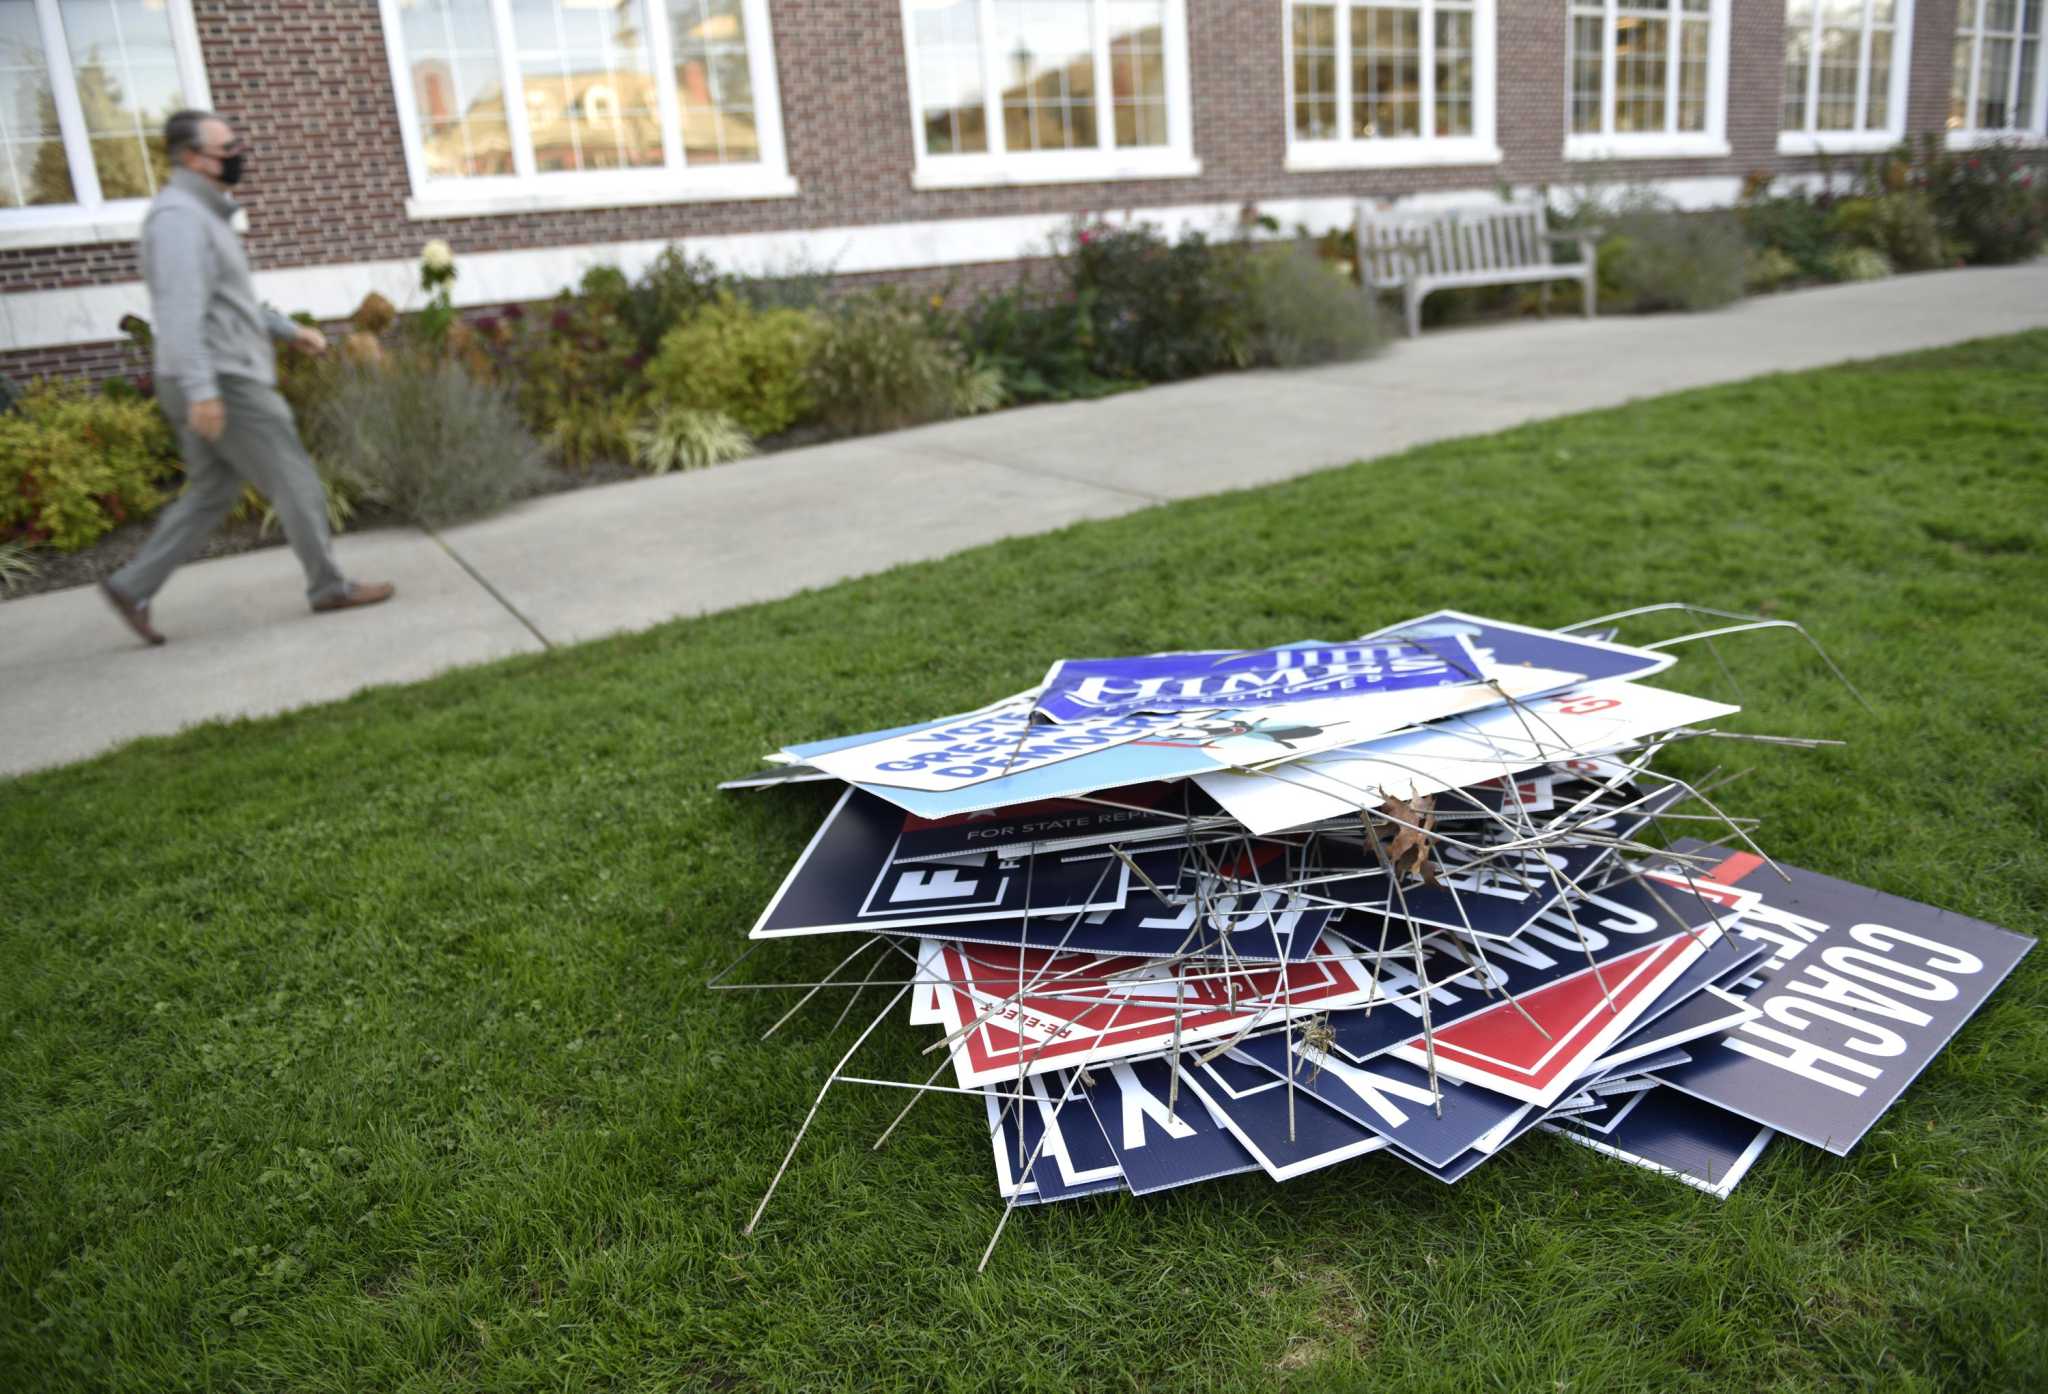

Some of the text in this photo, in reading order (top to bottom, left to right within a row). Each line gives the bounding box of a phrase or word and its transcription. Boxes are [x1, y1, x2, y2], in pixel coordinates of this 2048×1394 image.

[875, 721, 1083, 772] GREEN
[907, 712, 1027, 743] VOTE
[967, 826, 1018, 841] FOR
[1022, 815, 1090, 833] STATE
[1721, 922, 1985, 1098] COACH
